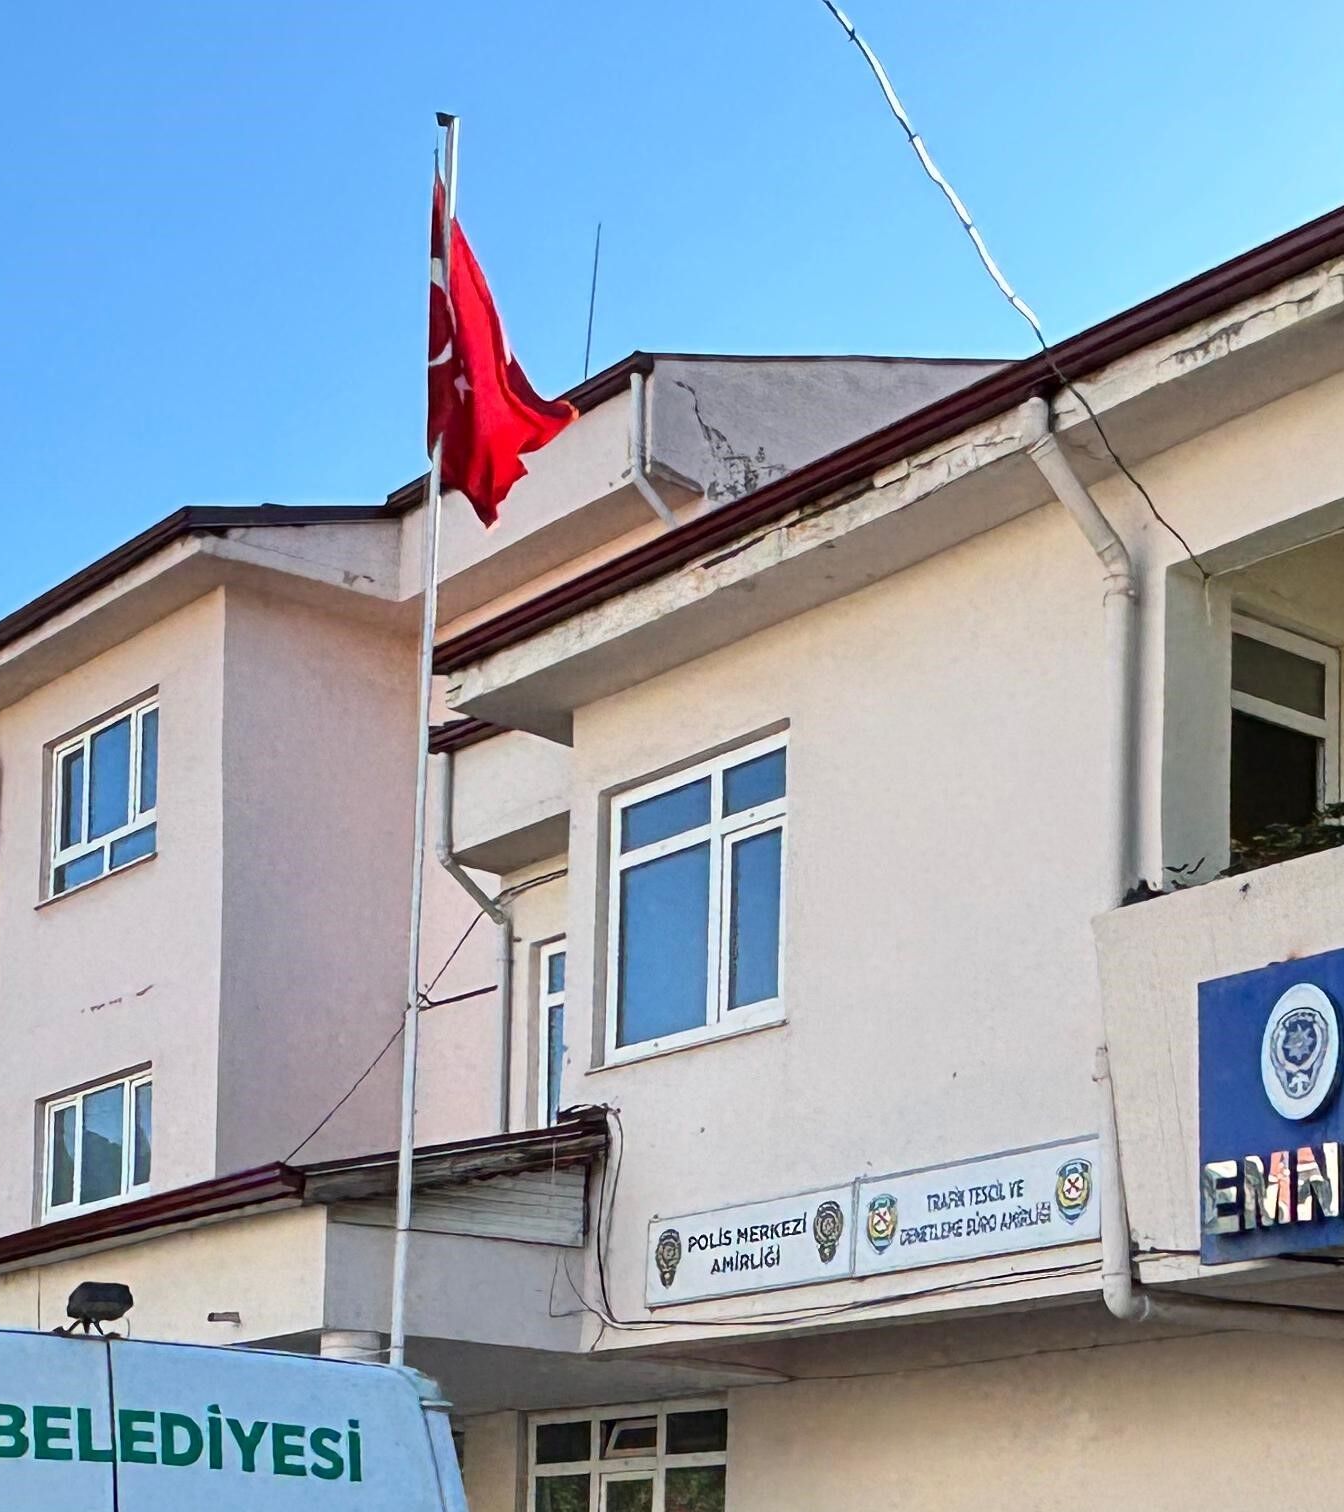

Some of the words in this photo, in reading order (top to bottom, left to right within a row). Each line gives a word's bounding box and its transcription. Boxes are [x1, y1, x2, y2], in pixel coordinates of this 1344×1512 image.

[687, 1226, 733, 1253] POLİS
[736, 1211, 808, 1245] MERKEZİ
[710, 1243, 781, 1275] AMİRLİĞİ
